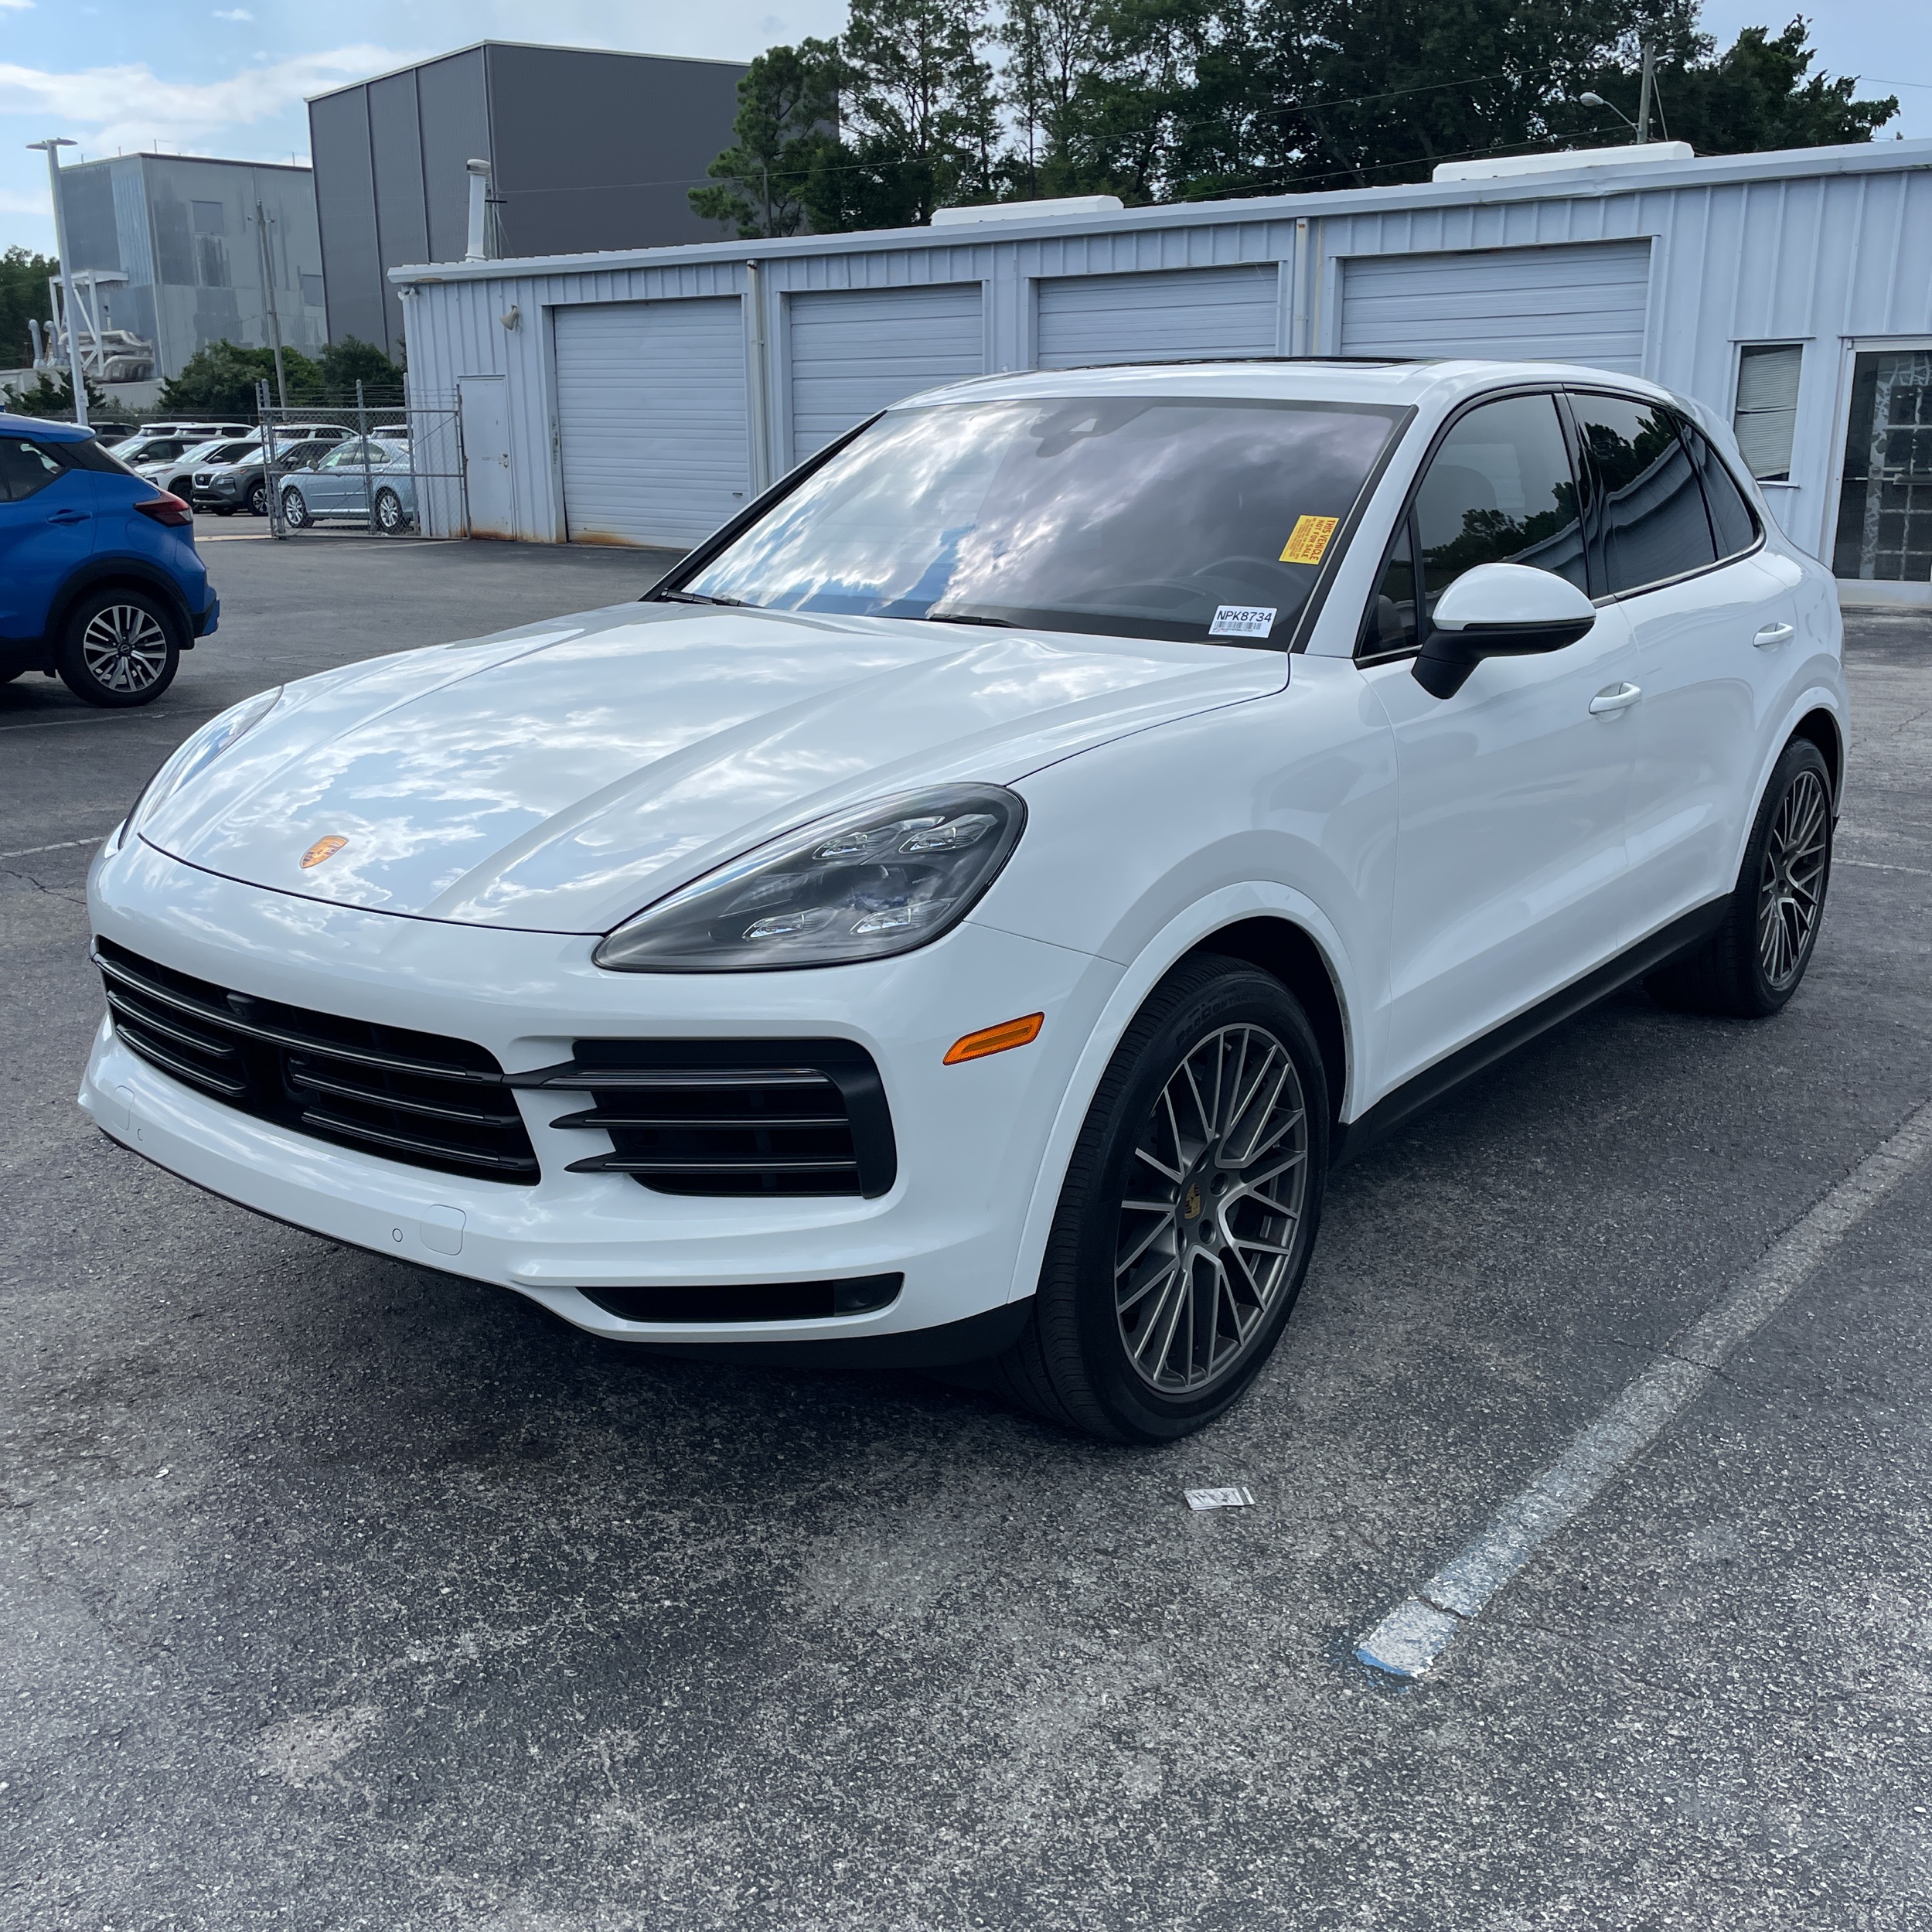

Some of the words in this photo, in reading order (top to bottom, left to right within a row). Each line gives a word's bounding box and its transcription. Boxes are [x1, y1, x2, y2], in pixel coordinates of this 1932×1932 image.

[1316, 520, 1325, 530] NOT
[1322, 520, 1336, 533] THIS
[1308, 532, 1319, 543] FOR
[1301, 544, 1314, 558] SALE
[1310, 534, 1329, 561] VEHICLE
[1216, 610, 1272, 622] NPK8734
